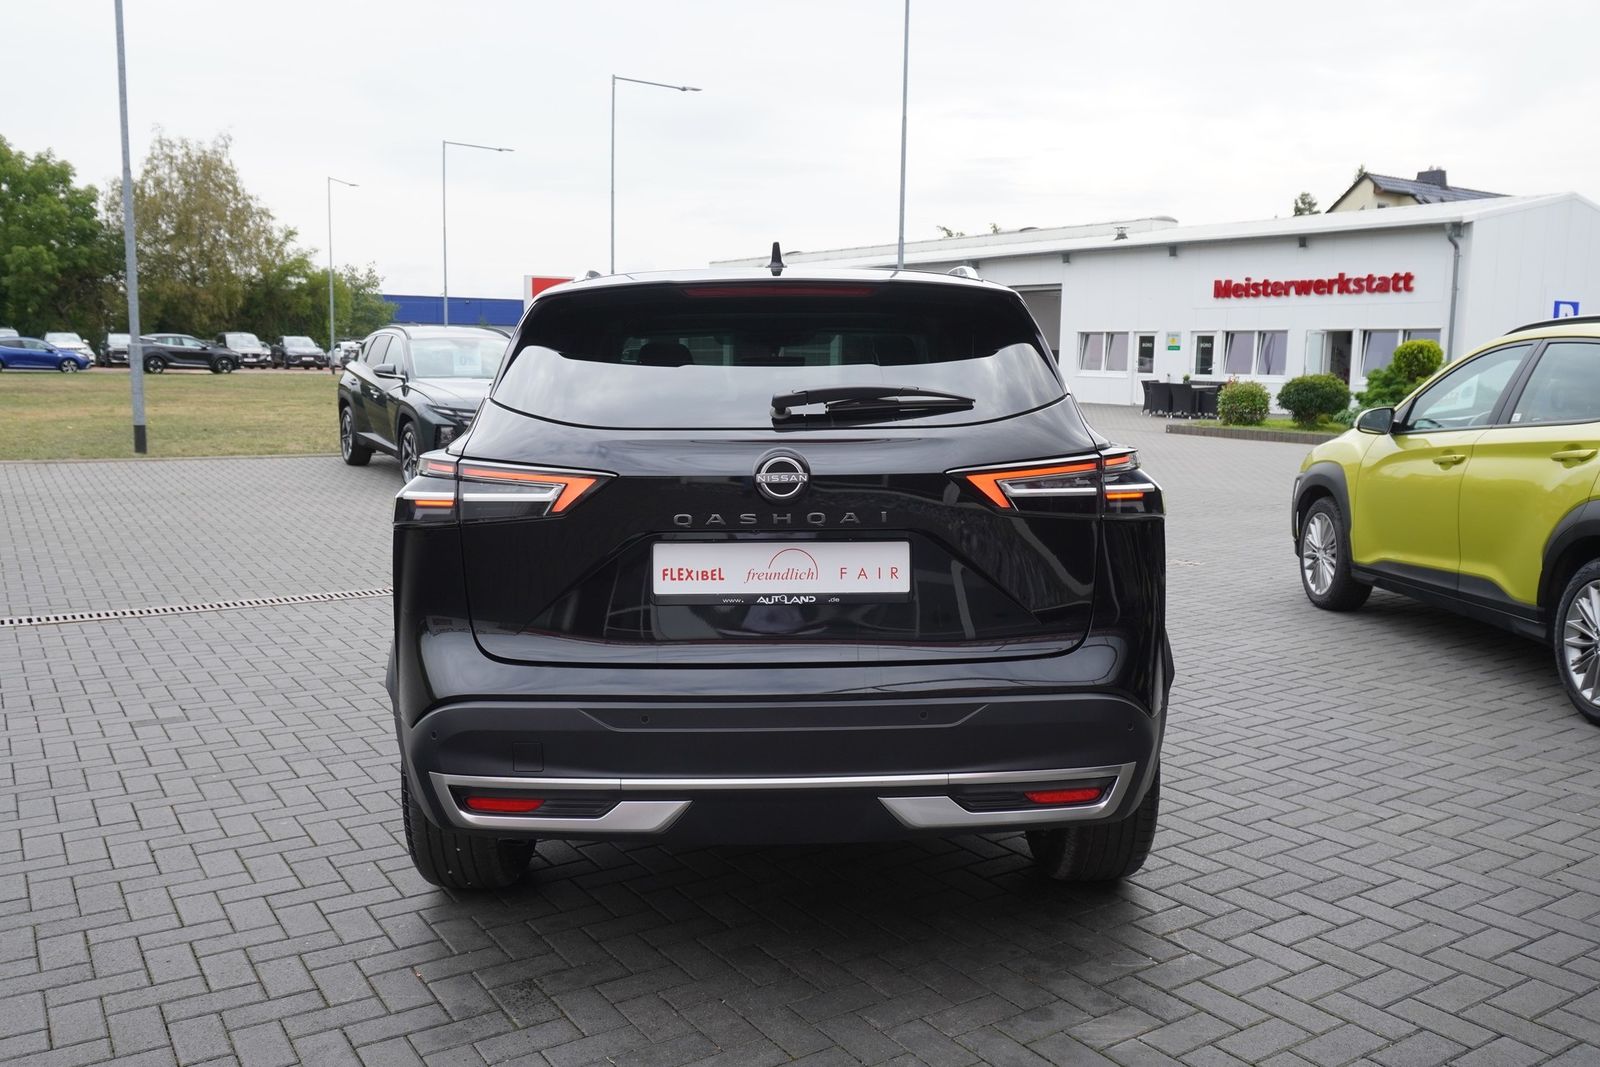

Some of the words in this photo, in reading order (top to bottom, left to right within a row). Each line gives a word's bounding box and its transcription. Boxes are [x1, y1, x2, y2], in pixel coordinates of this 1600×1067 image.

[1213, 272, 1415, 299] Meisterwerkstatt
[757, 474, 807, 482] NISSAN
[673, 511, 888, 528] QASHQAI
[662, 567, 725, 582] FLEXIBEL
[744, 568, 815, 584] freundlich
[840, 567, 899, 580] FAIR
